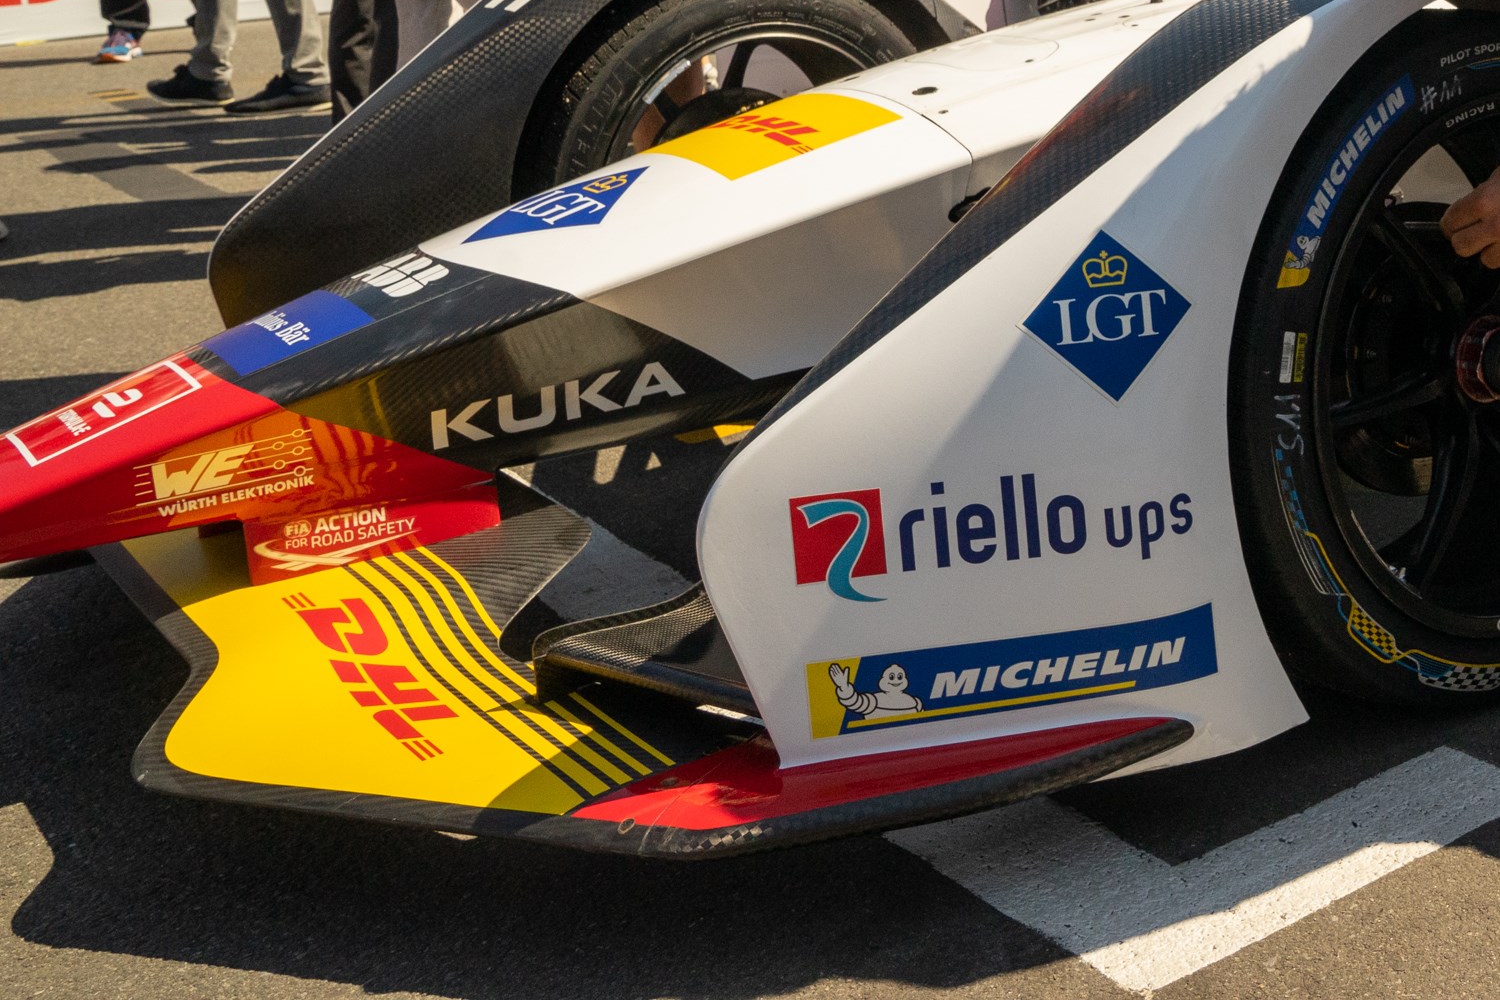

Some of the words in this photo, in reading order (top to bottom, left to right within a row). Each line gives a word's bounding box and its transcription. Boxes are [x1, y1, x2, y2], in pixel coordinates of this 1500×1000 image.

[1440, 50, 1471, 67] PILOT
[1446, 102, 1496, 129] RACING
[1306, 86, 1406, 230] MICHELIN
[510, 190, 606, 226] LGT
[351, 252, 450, 298] ABB
[275, 321, 311, 347] Bär
[1053, 289, 1167, 346] LGT
[431, 361, 687, 451] KUKA
[152, 445, 254, 500] WE
[158, 496, 217, 518] WÜRTH
[221, 475, 315, 505] ELEKTRONIK
[285, 537, 308, 550] FOR
[311, 528, 354, 548] ROAD
[358, 518, 416, 541] SAFETY
[315, 507, 387, 534] ACTION
[899, 473, 1088, 573] riello
[1104, 493, 1194, 561] ups
[292, 595, 460, 748] DHL
[929, 636, 1187, 700] MICHELIN
